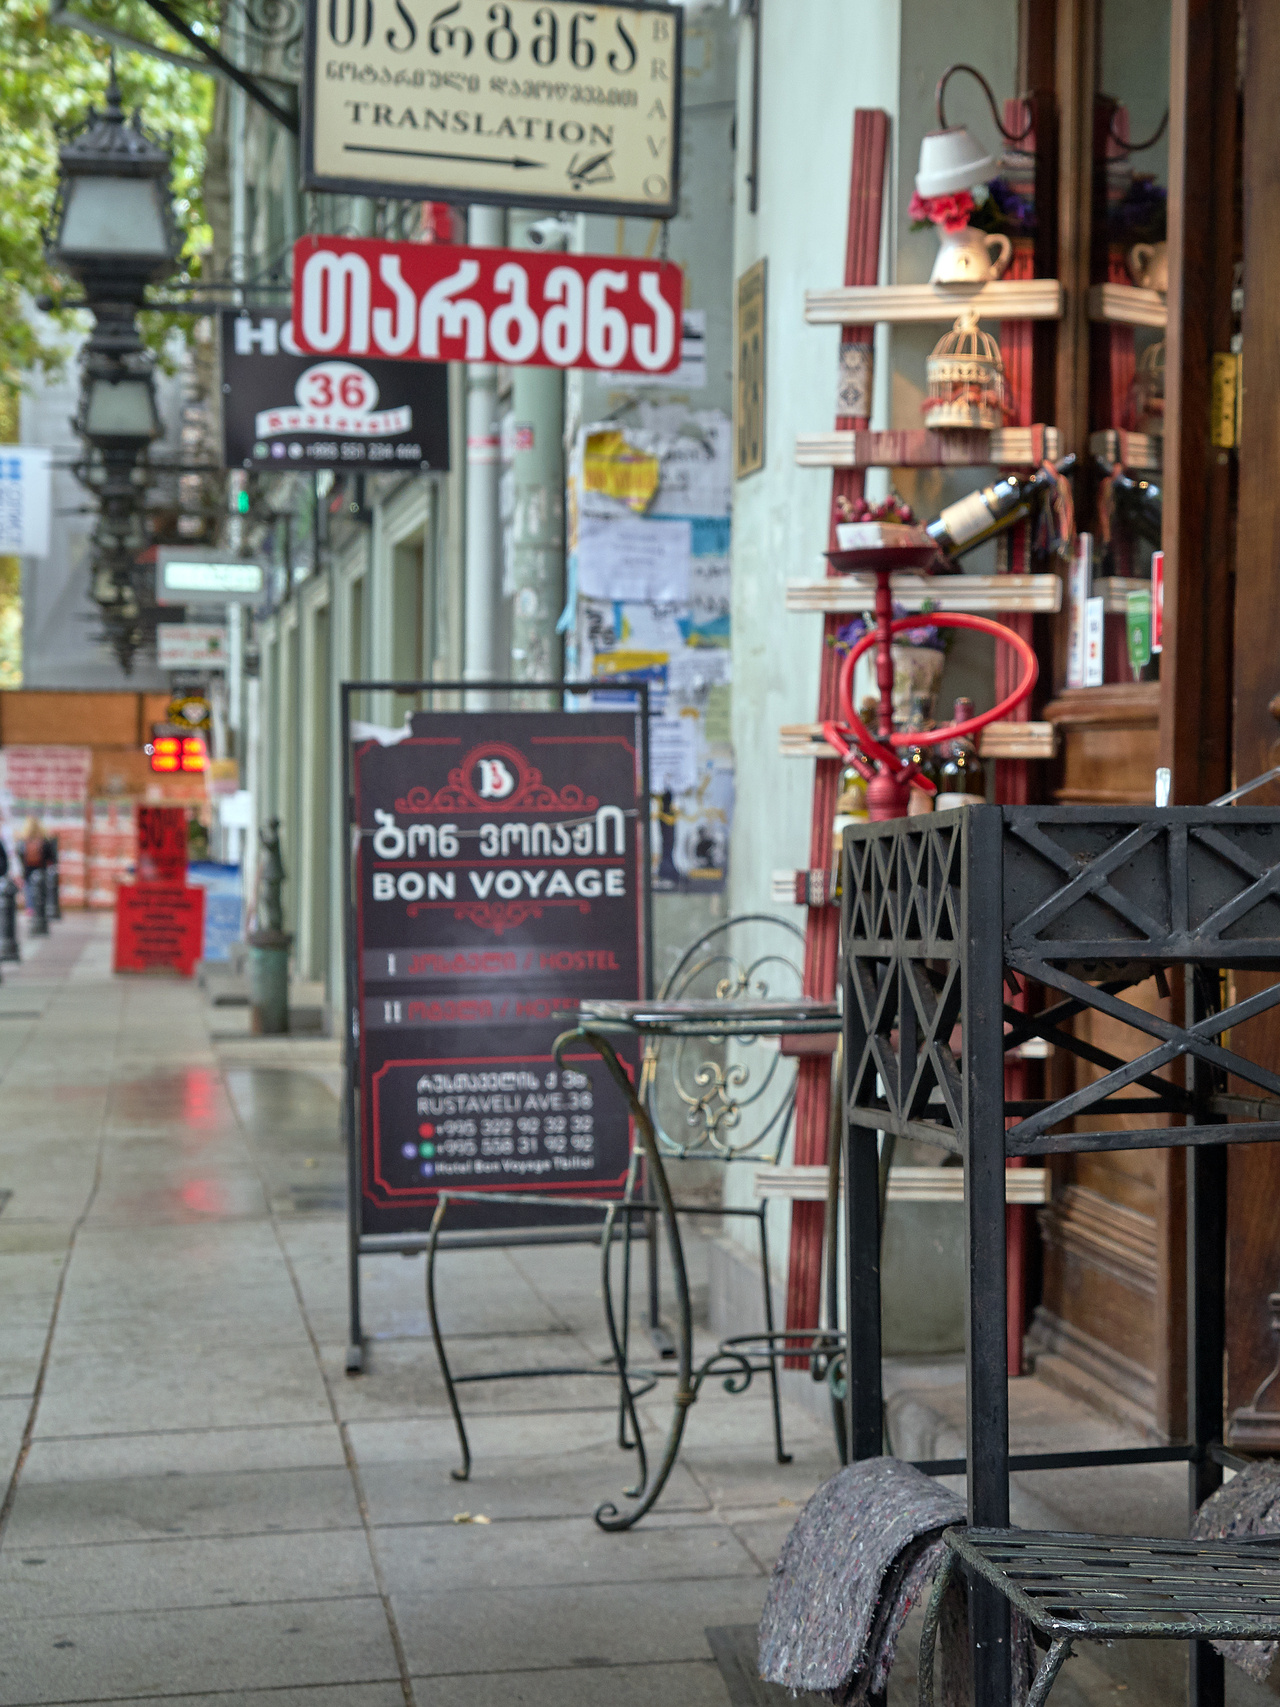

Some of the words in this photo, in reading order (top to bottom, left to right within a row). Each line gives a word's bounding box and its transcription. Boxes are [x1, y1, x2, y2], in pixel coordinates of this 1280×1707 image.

[328, 0, 637, 74] თარგმნა
[346, 100, 614, 147] TRANSLATION
[301, 250, 675, 370] თარგმნა
[308, 371, 366, 409] 36
[267, 412, 403, 434] Rustaveli
[373, 808, 460, 859] ბონ
[479, 805, 626, 856] ვოიაჟი
[372, 871, 457, 900] BON
[469, 868, 627, 899] VOYAGE
[540, 950, 620, 972] HOSTEL
[417, 1093, 522, 1116] RUSTAVELI
